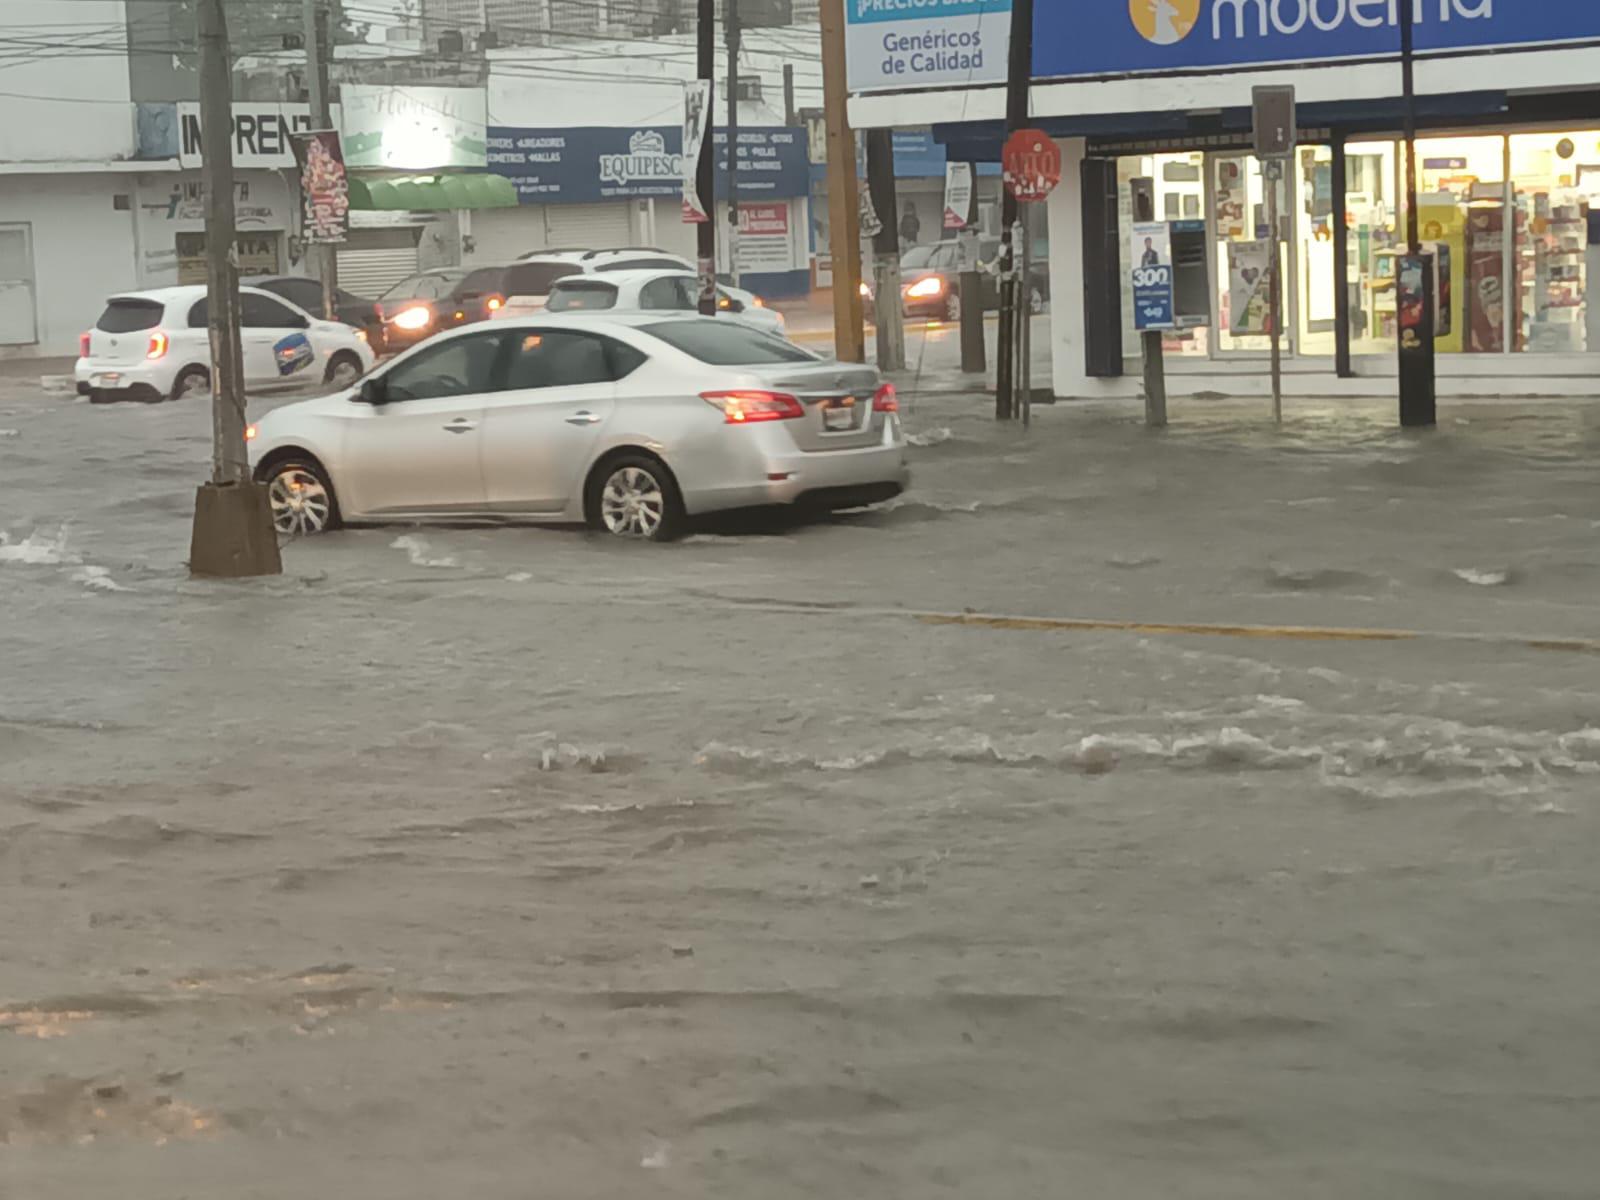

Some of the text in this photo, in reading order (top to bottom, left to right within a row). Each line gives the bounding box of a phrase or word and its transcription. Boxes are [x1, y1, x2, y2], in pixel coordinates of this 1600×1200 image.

[883, 30, 981, 52] Genéricos
[882, 50, 983, 74] de Calidad
[1133, 267, 1169, 287] 300
